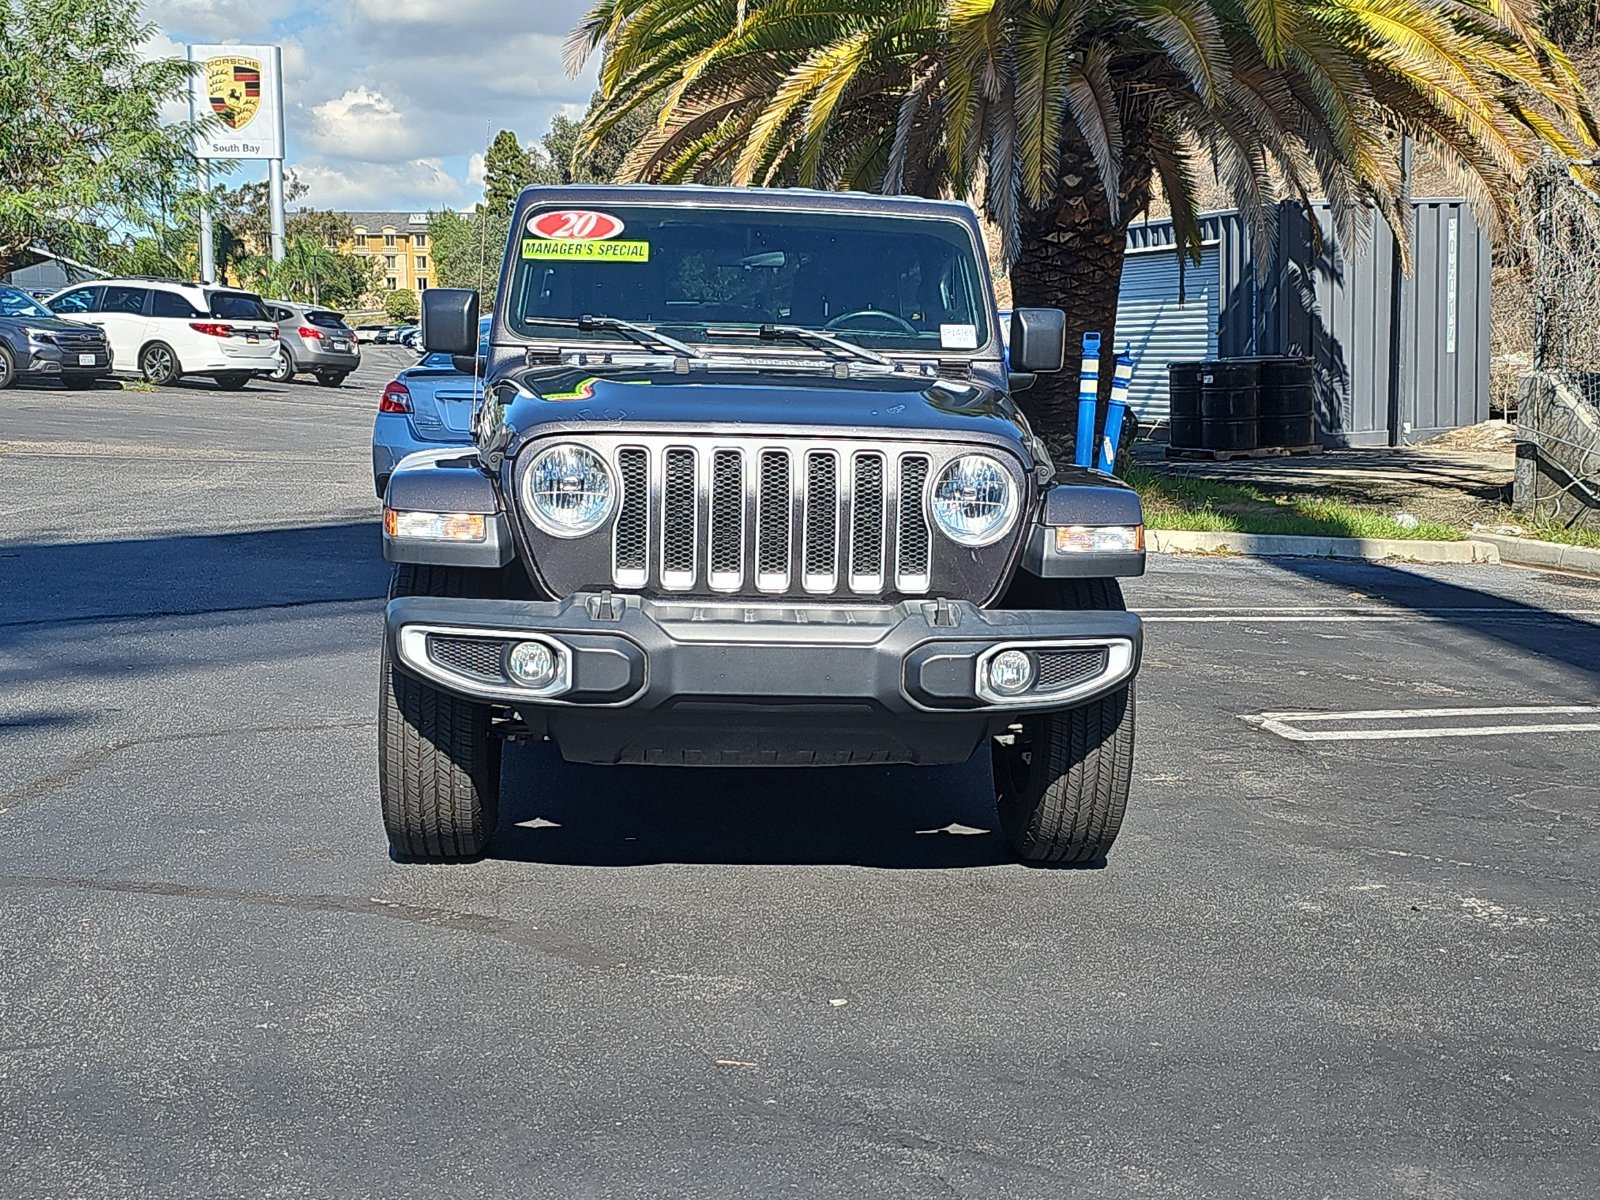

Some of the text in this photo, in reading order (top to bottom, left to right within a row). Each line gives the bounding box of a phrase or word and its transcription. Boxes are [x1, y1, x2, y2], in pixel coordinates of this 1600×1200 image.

[207, 58, 260, 70] PORSCHE
[212, 143, 261, 155] South Bay
[549, 212, 599, 238] 20
[524, 242, 645, 257] MANAGER'S SPECIAL
